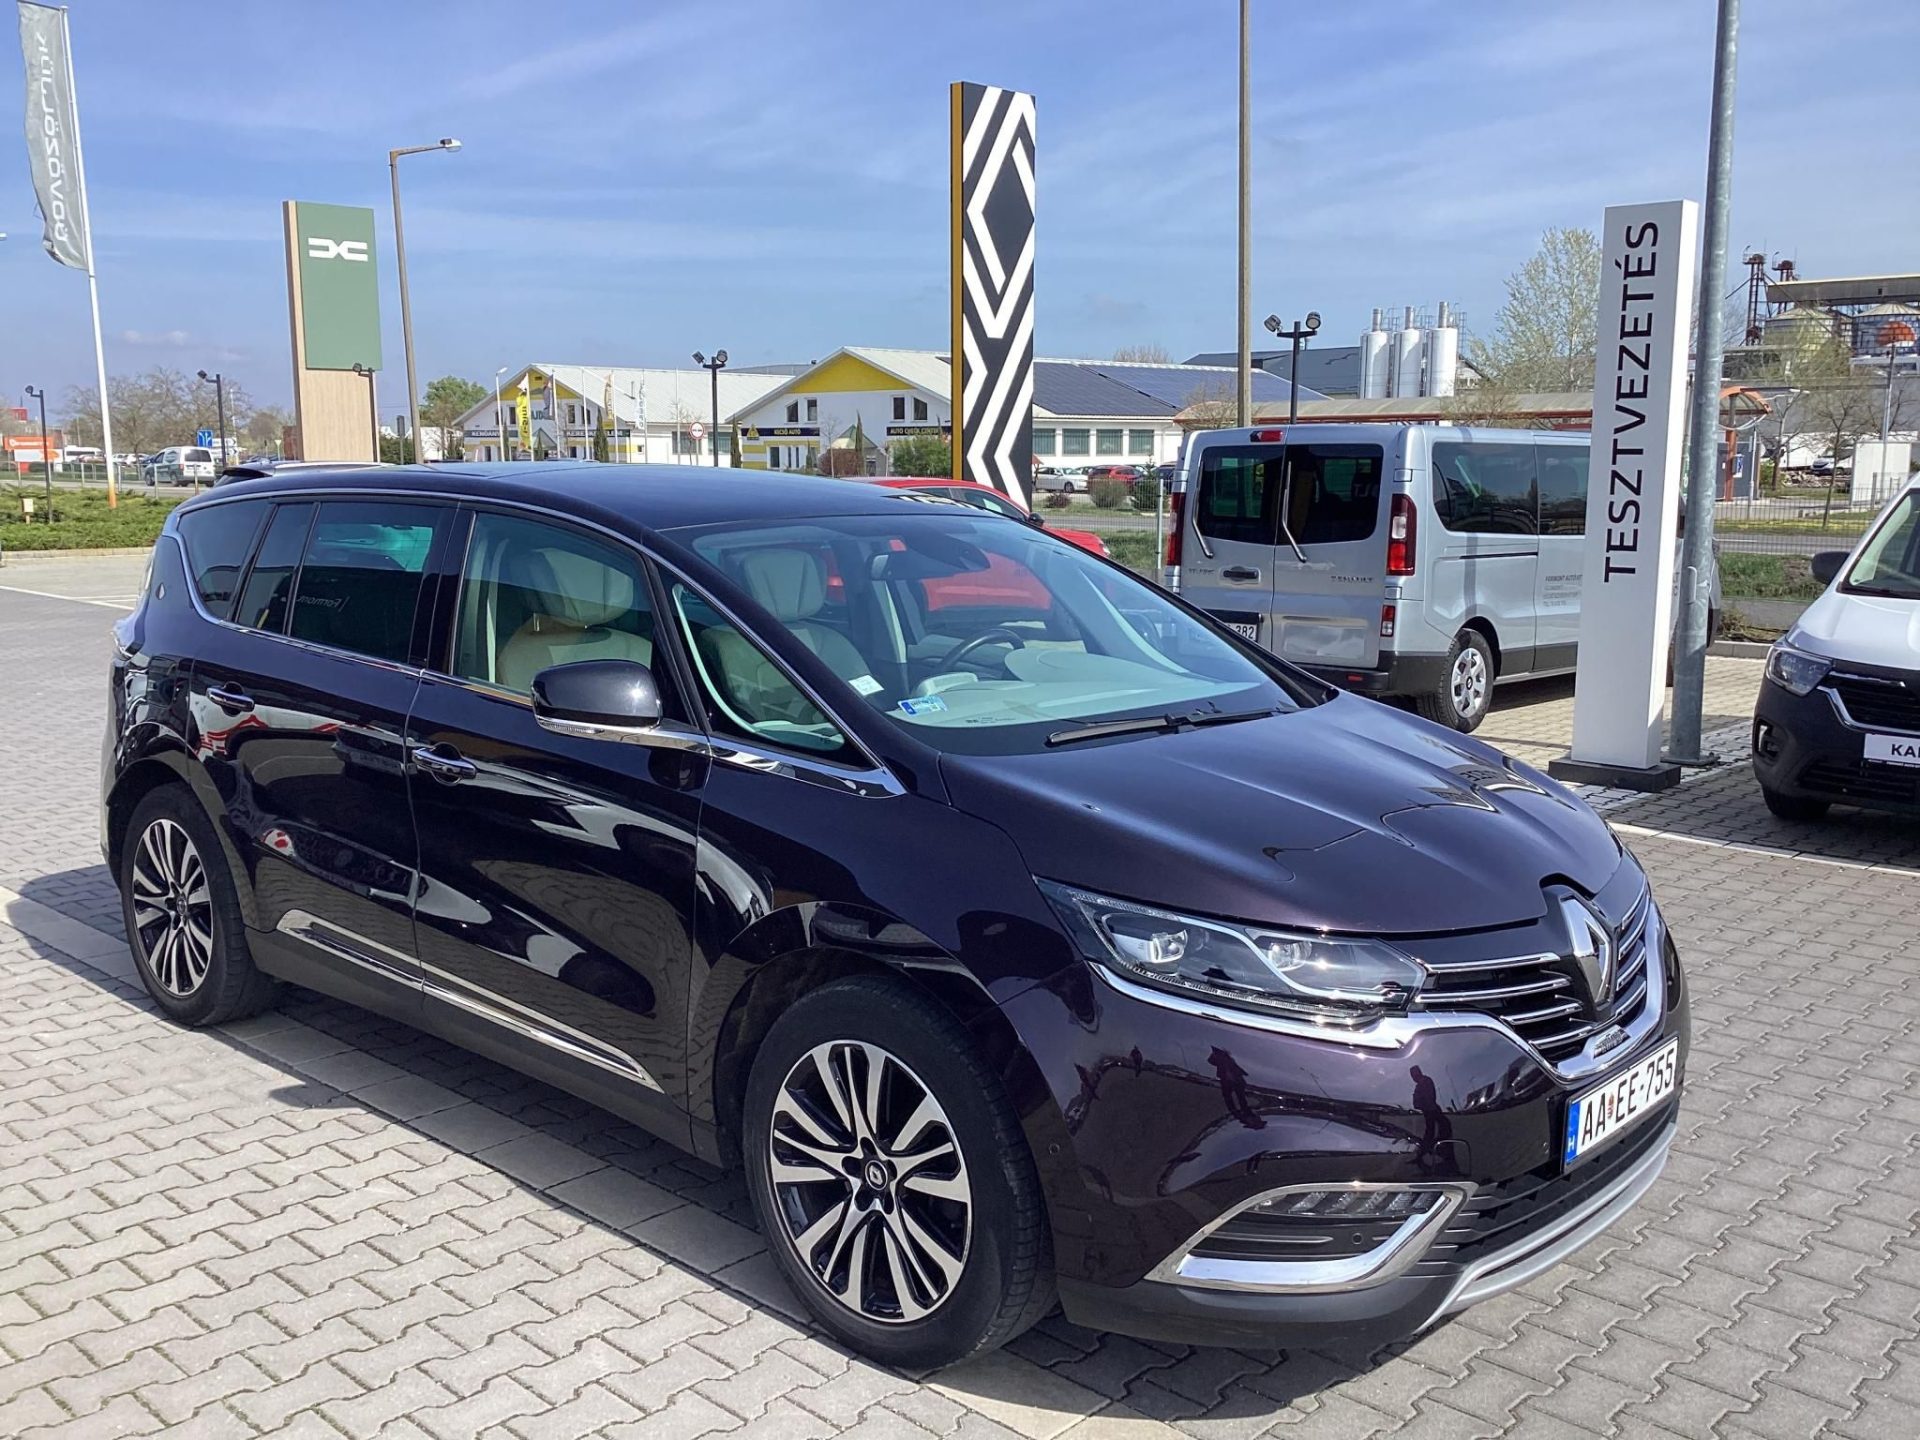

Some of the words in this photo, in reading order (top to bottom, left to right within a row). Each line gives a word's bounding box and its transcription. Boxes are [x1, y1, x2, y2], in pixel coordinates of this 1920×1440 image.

[1604, 221, 1659, 583] TESZTVEZETÉS
[1891, 744, 1920, 758] KA
[1581, 1092, 1606, 1146] AA
